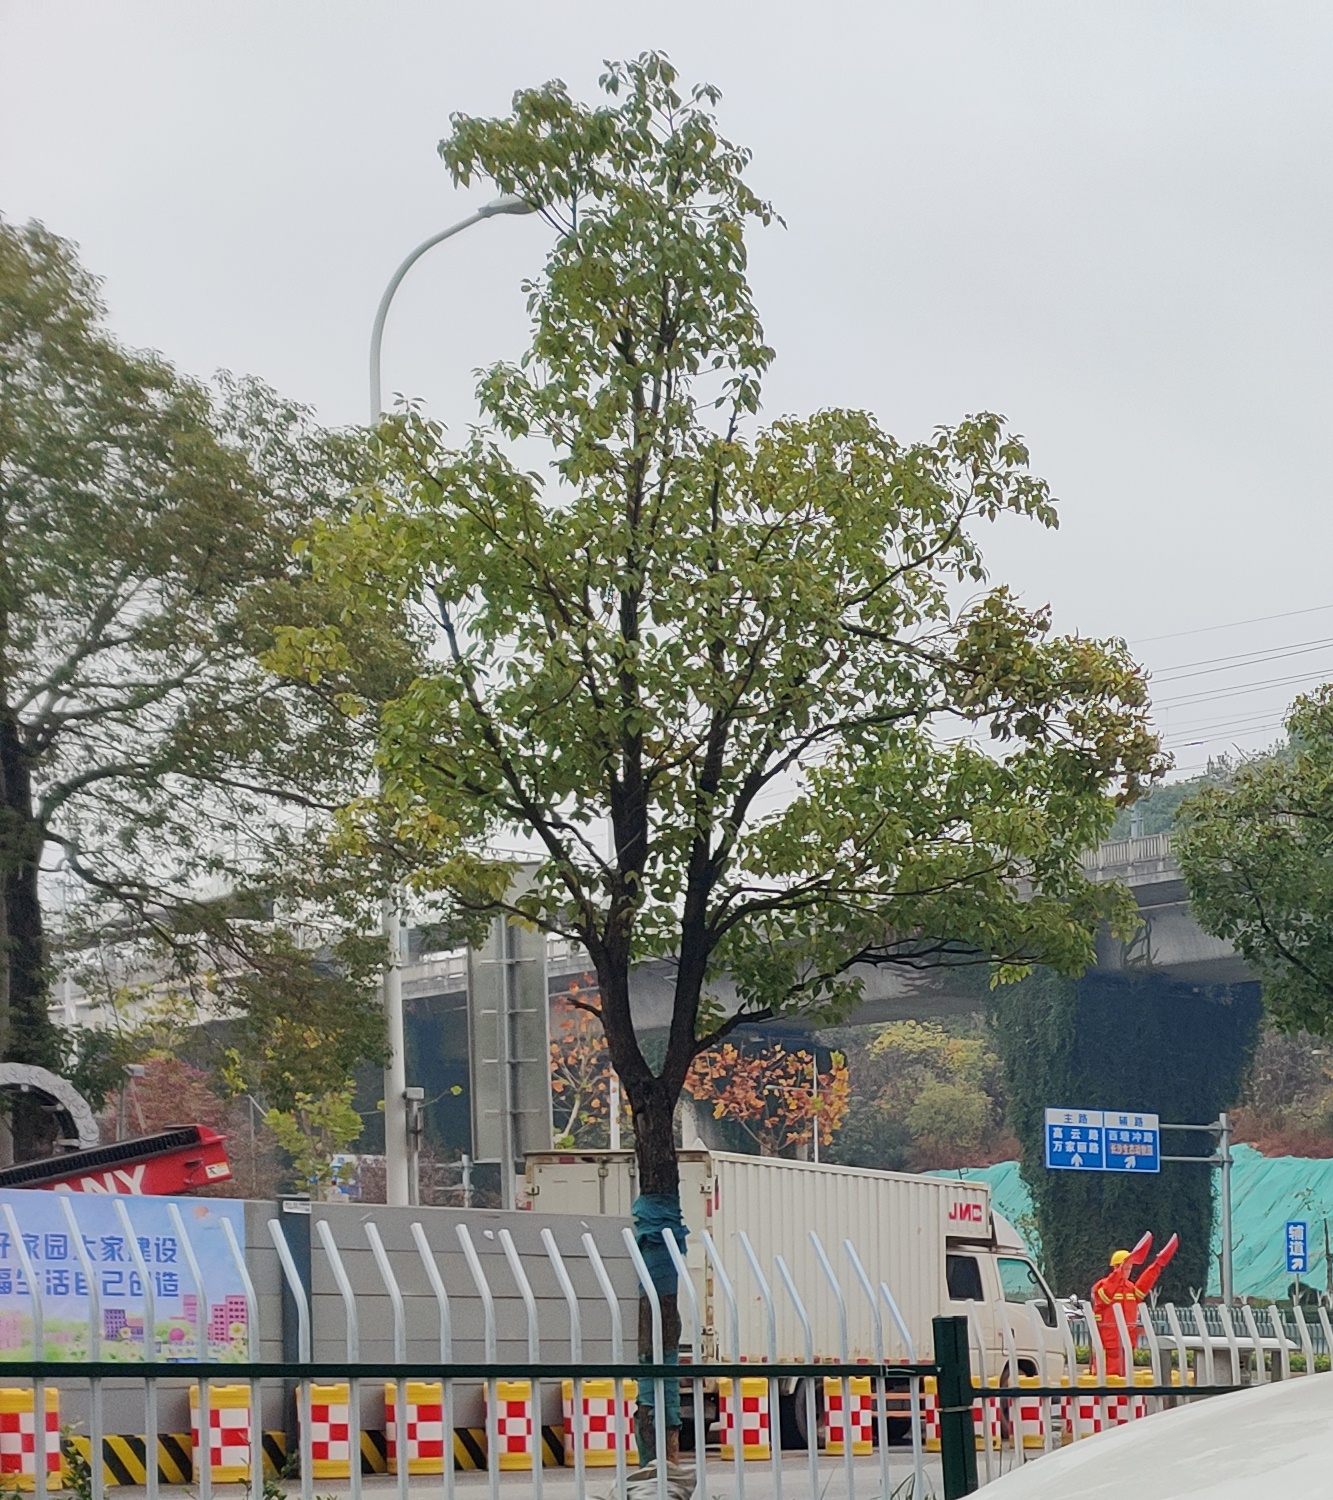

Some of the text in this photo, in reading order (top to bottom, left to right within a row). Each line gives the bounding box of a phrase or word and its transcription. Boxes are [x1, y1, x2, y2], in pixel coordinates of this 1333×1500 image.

[1064, 1114, 1087, 1124] 主路
[1119, 1116, 1143, 1127] 辅路
[1288, 1225, 1305, 1256] 辅道
